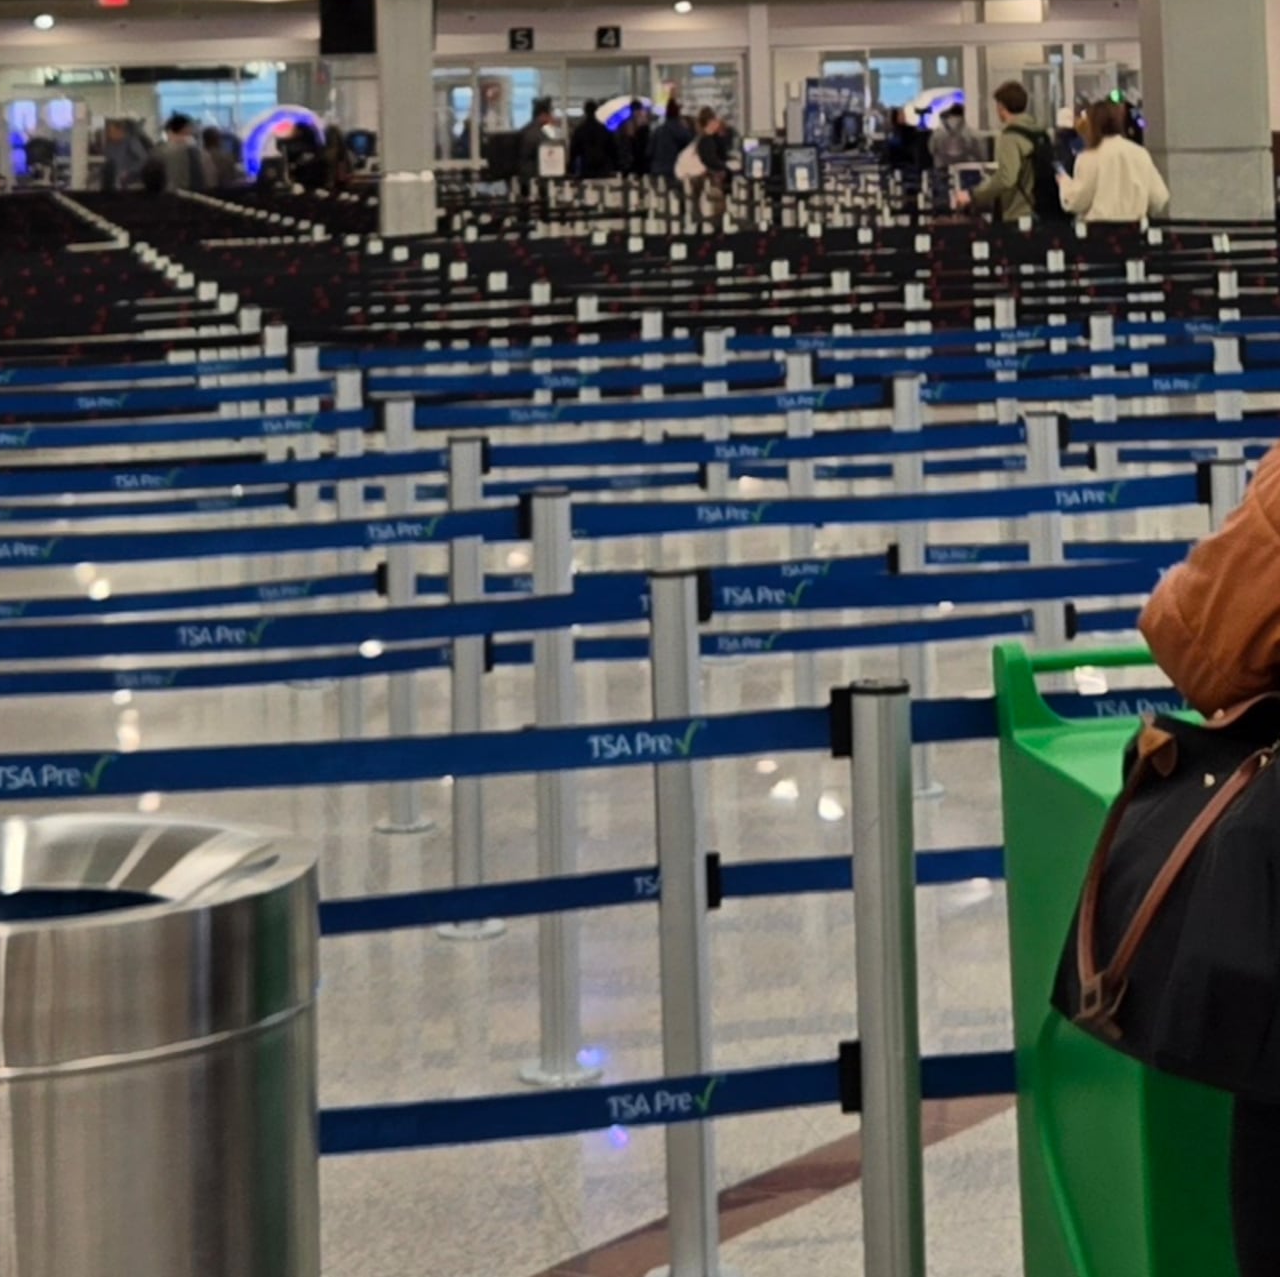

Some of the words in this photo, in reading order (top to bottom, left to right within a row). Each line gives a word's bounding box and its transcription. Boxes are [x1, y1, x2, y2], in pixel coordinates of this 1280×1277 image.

[722, 587, 754, 606] TSA
[757, 585, 788, 604] Pre
[176, 627, 213, 647] TSA
[216, 625, 248, 645] Pre
[586, 734, 631, 759] TSA
[635, 731, 674, 756] Pre
[41, 764, 82, 789] Pre
[607, 1094, 651, 1119] TSA
[654, 1090, 693, 1112] Pre
